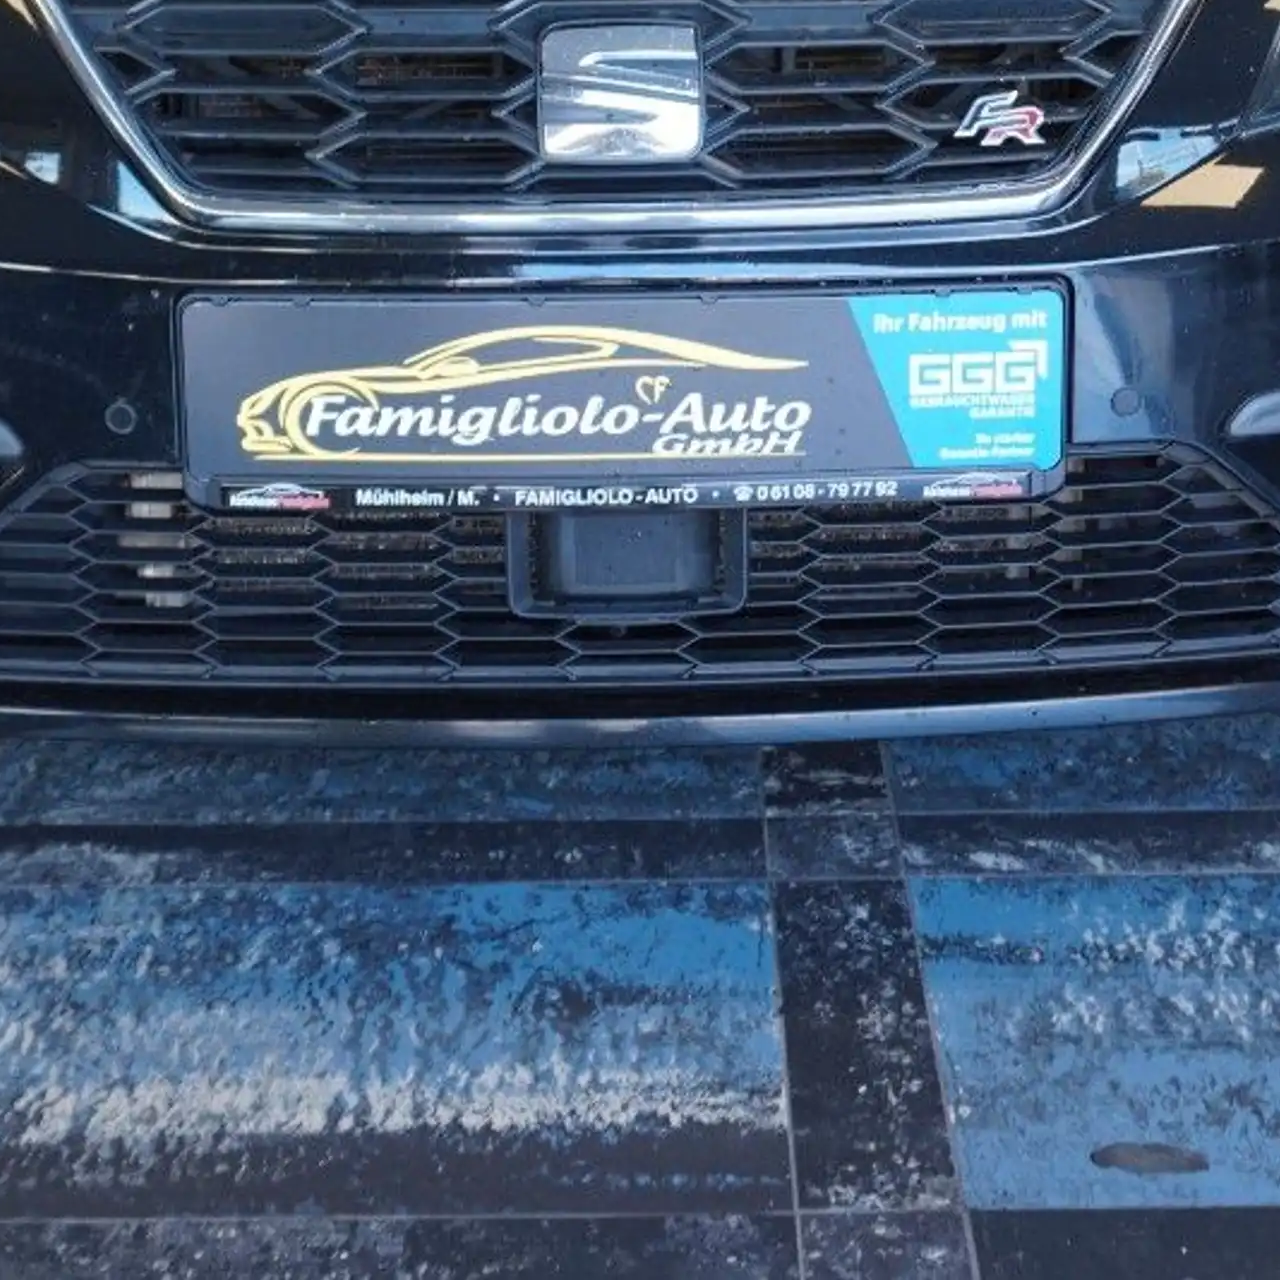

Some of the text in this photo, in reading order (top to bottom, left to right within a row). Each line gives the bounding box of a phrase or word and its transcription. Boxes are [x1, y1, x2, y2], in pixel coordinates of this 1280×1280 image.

[953, 90, 1046, 146] FR
[908, 310, 1006, 333] Fahrzeug
[1011, 310, 1048, 328] mit
[909, 353, 1036, 395] GGG
[304, 392, 812, 446] Famigliolo-Auto
[651, 429, 804, 456] GmbH
